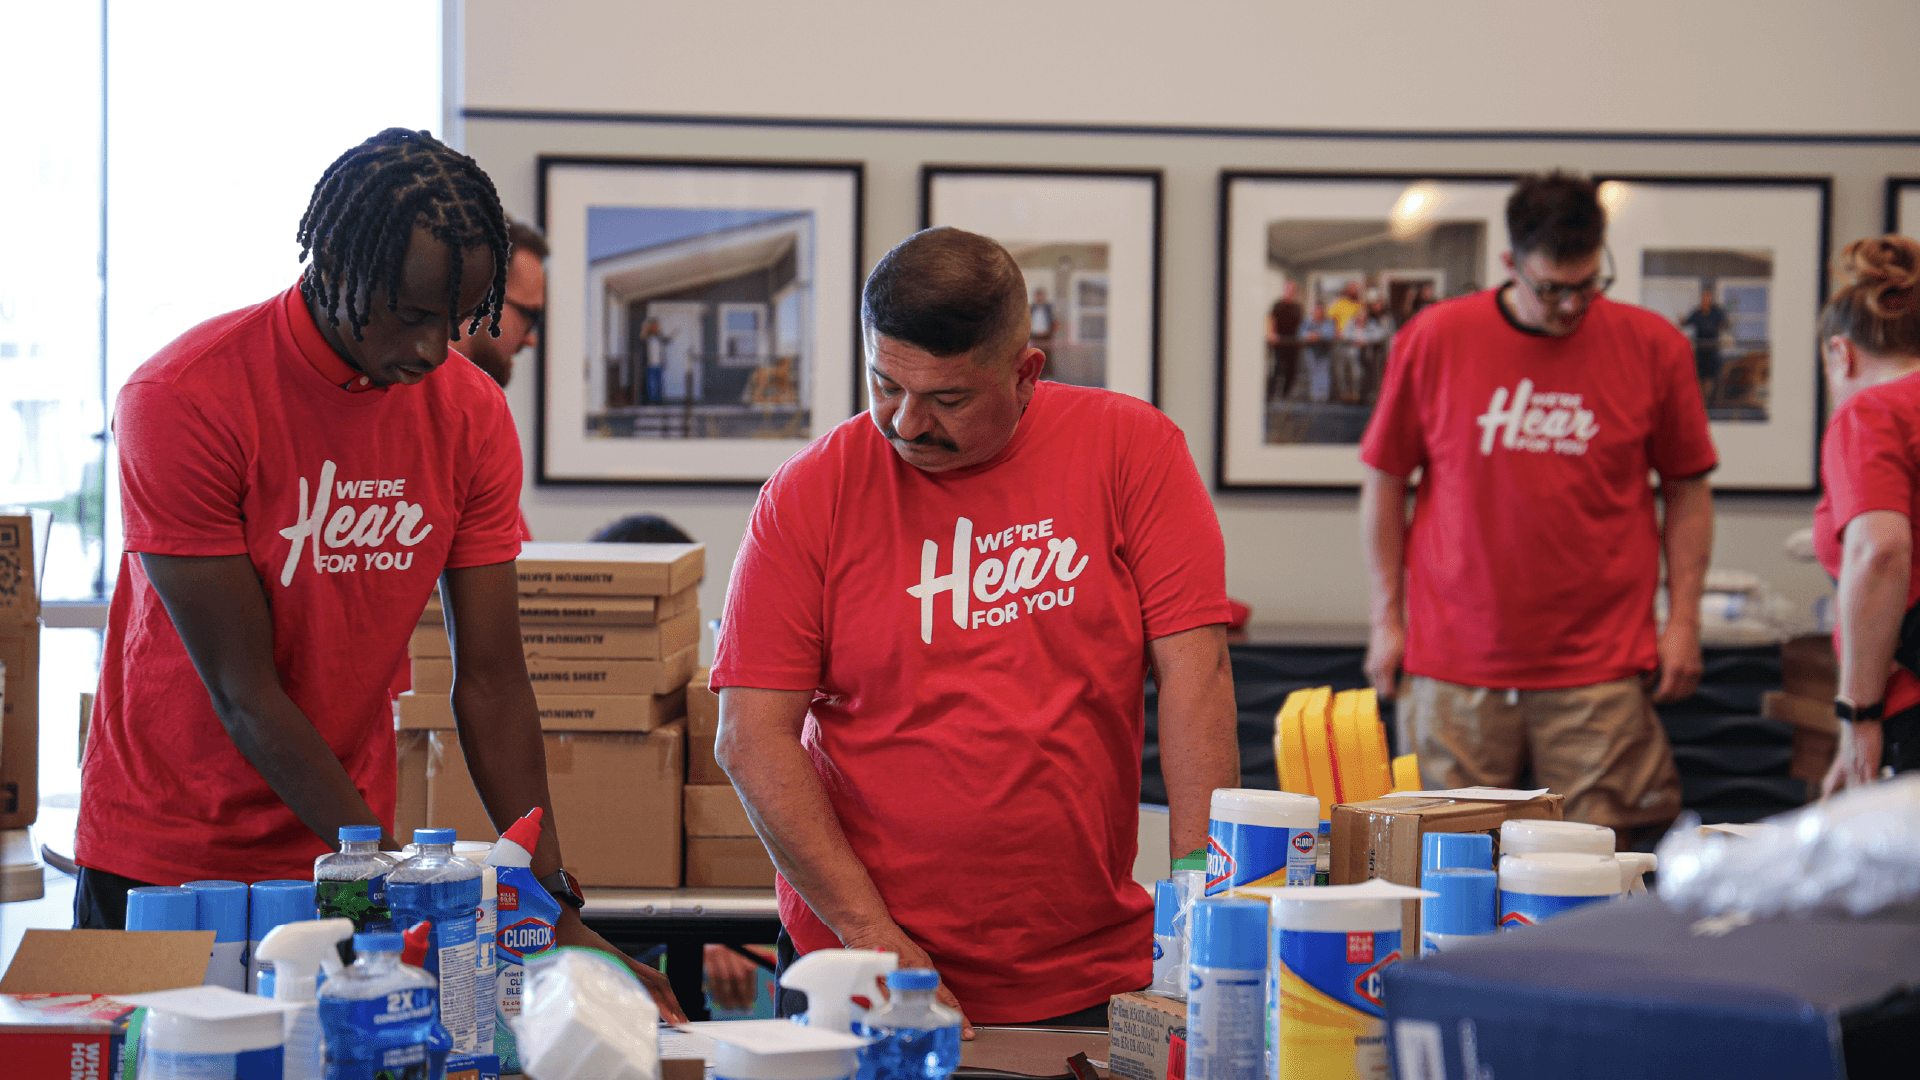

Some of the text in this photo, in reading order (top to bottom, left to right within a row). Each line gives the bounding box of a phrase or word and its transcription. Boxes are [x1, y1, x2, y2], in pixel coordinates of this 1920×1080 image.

[1477, 377, 1600, 456] Hear
[336, 478, 406, 499] WE'RE
[279, 459, 433, 587] Hear
[975, 518, 1054, 554] WE'RE
[319, 551, 414, 574] FOR YOU
[555, 572, 613, 583] ALUMINUM
[906, 516, 1090, 645] Hear
[520, 608, 596, 617] BAKING SHEET
[972, 586, 1075, 629] FOR YOU
[546, 634, 604, 644] ALUMINUM
[530, 672, 607, 682] BAKING SHEET
[504, 926, 552, 948] CLOROX
[386, 991, 414, 1013] 2X
[506, 987, 522, 995] BLE
